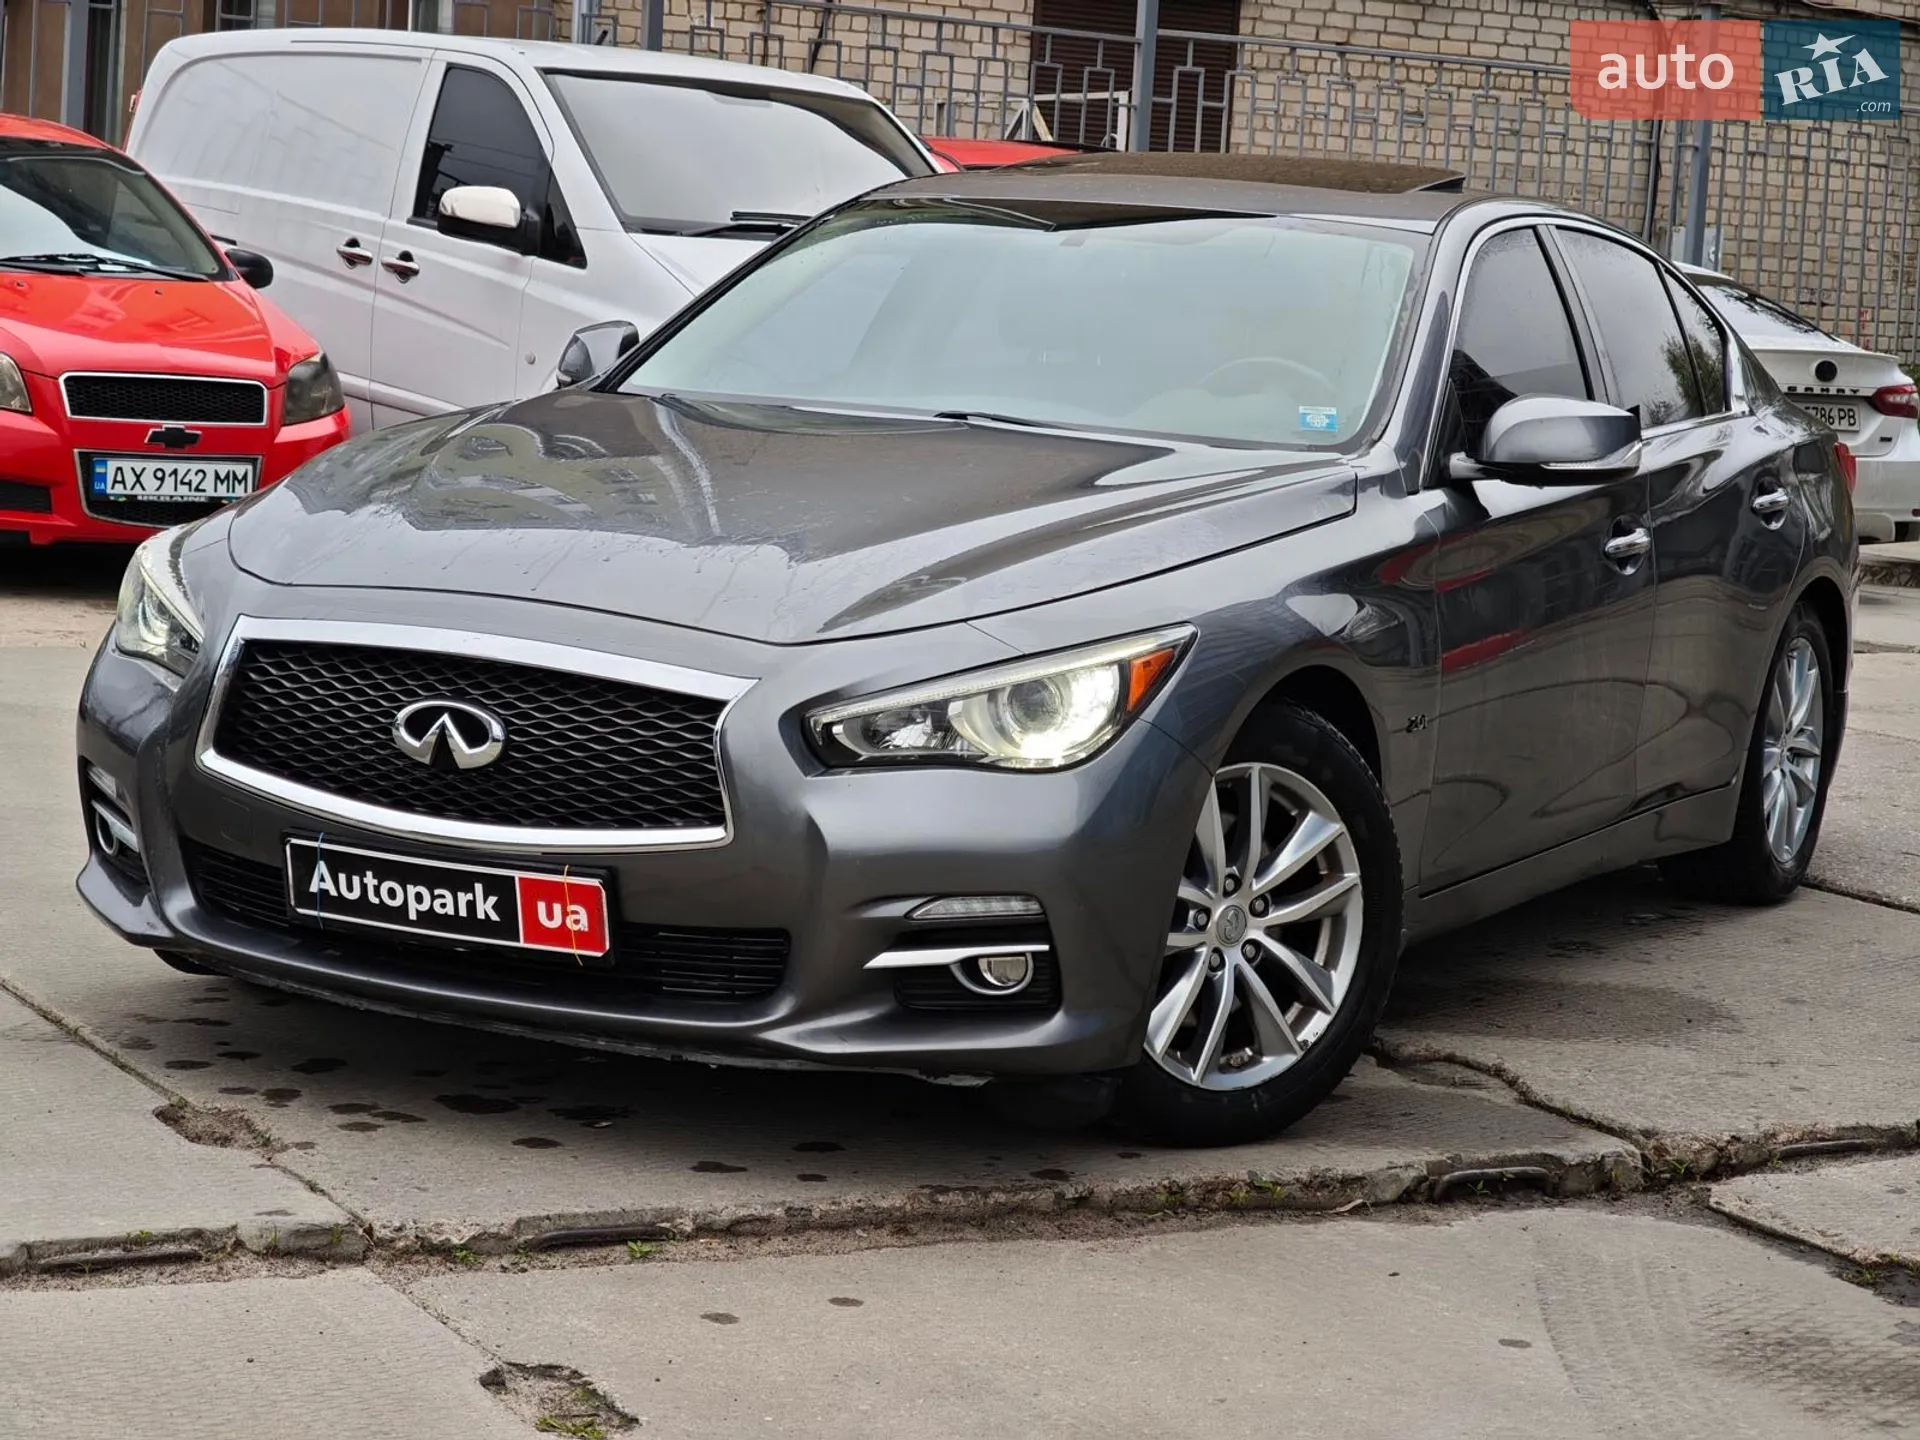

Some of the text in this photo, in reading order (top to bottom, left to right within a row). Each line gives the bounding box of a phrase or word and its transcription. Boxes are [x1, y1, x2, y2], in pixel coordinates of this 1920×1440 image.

[1804, 406, 1857, 426] 786 PB
[94, 481, 106, 490] UA
[110, 466, 249, 494] AX 9142 MM
[308, 860, 589, 931] Autopark ua
